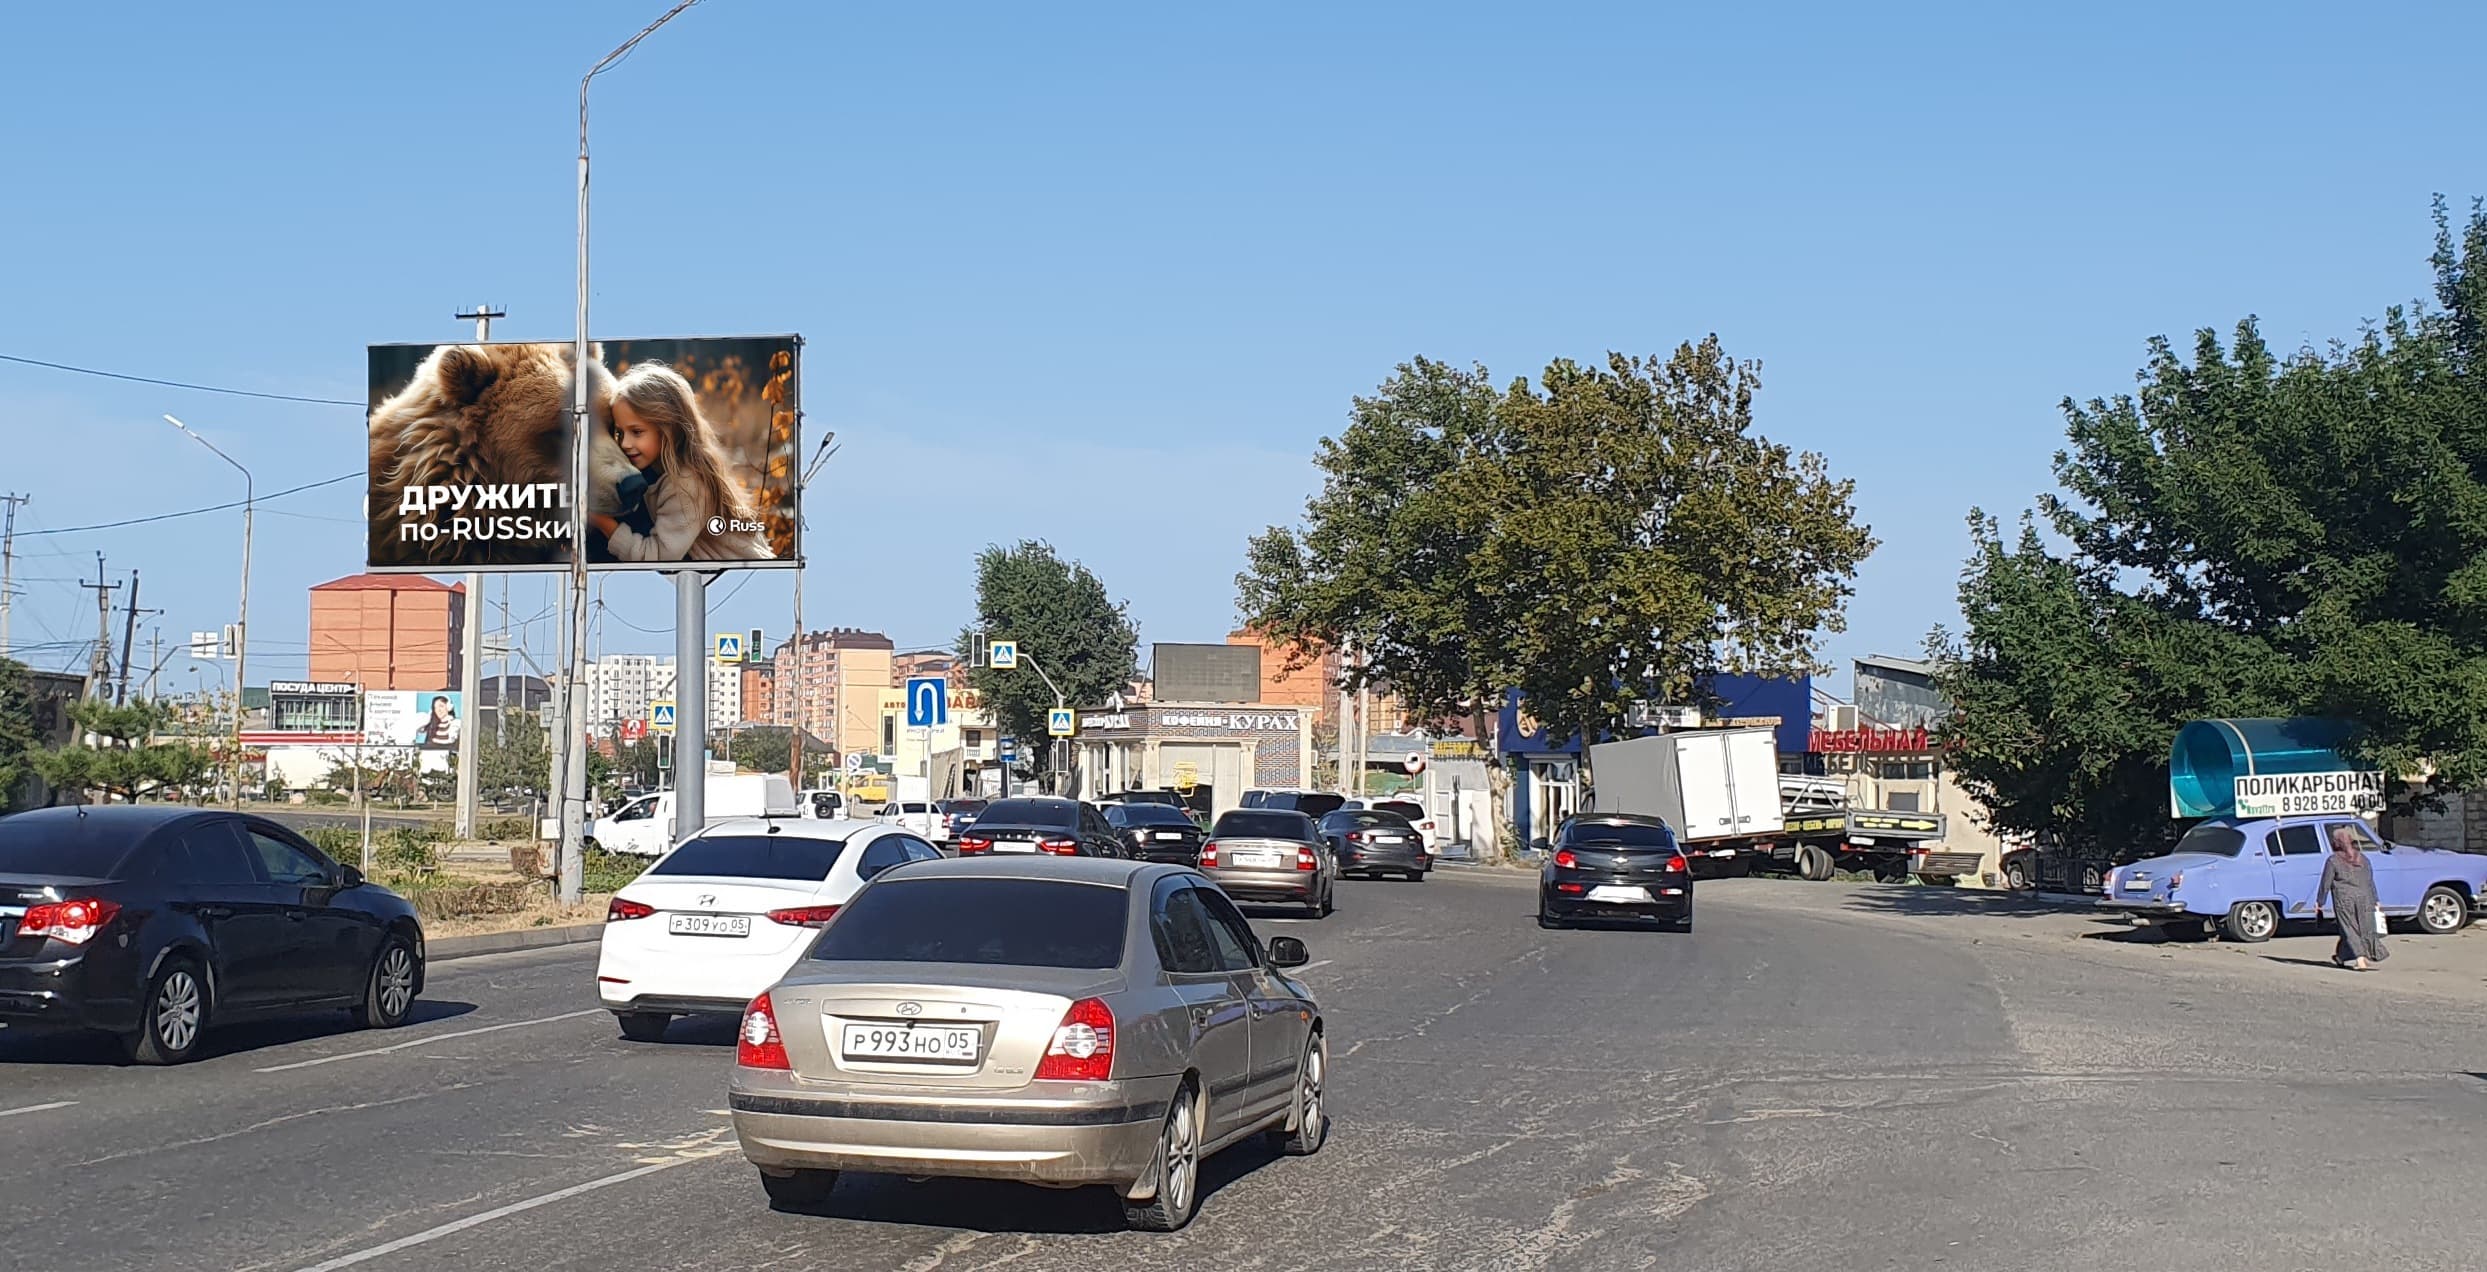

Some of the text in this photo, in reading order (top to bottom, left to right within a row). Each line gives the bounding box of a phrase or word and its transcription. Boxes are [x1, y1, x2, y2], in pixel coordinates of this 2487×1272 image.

[401, 516, 571, 541] по-RUSSки
[730, 520, 765, 532] Russ
[272, 682, 350, 694] ПОСУДА ЦЕНТР
[1228, 715, 1298, 730] КУРАХ
[1808, 728, 1928, 752] МЕБЕЛЬНАЯ
[2236, 773, 2383, 796] ПОЛИКАРБОНАТ
[2282, 797, 2290, 812] 8
[2294, 796, 2318, 811] 928
[2322, 795, 2346, 810] 528
[947, 1032, 969, 1049] 05
